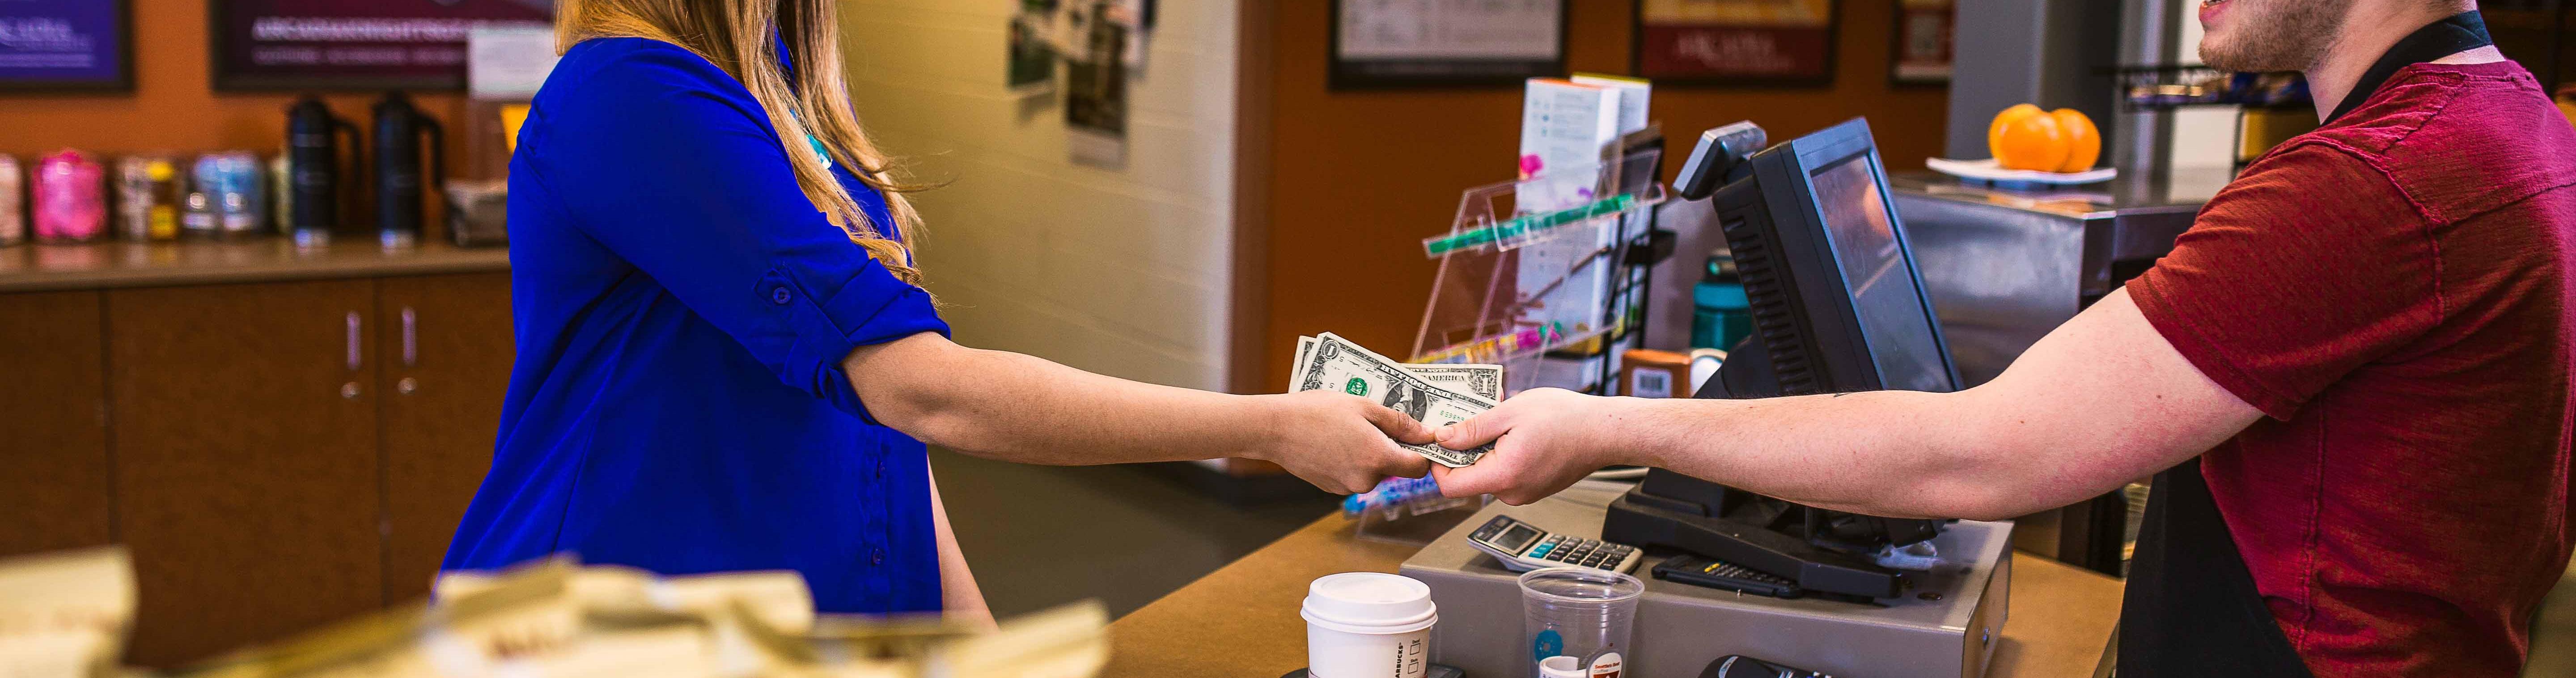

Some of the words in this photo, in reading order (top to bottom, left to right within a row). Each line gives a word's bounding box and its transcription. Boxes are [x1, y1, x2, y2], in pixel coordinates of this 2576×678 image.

[1381, 364, 1427, 390] DOLLAR
[1427, 385, 1453, 399] ONE
[1440, 451, 1458, 460] THE
